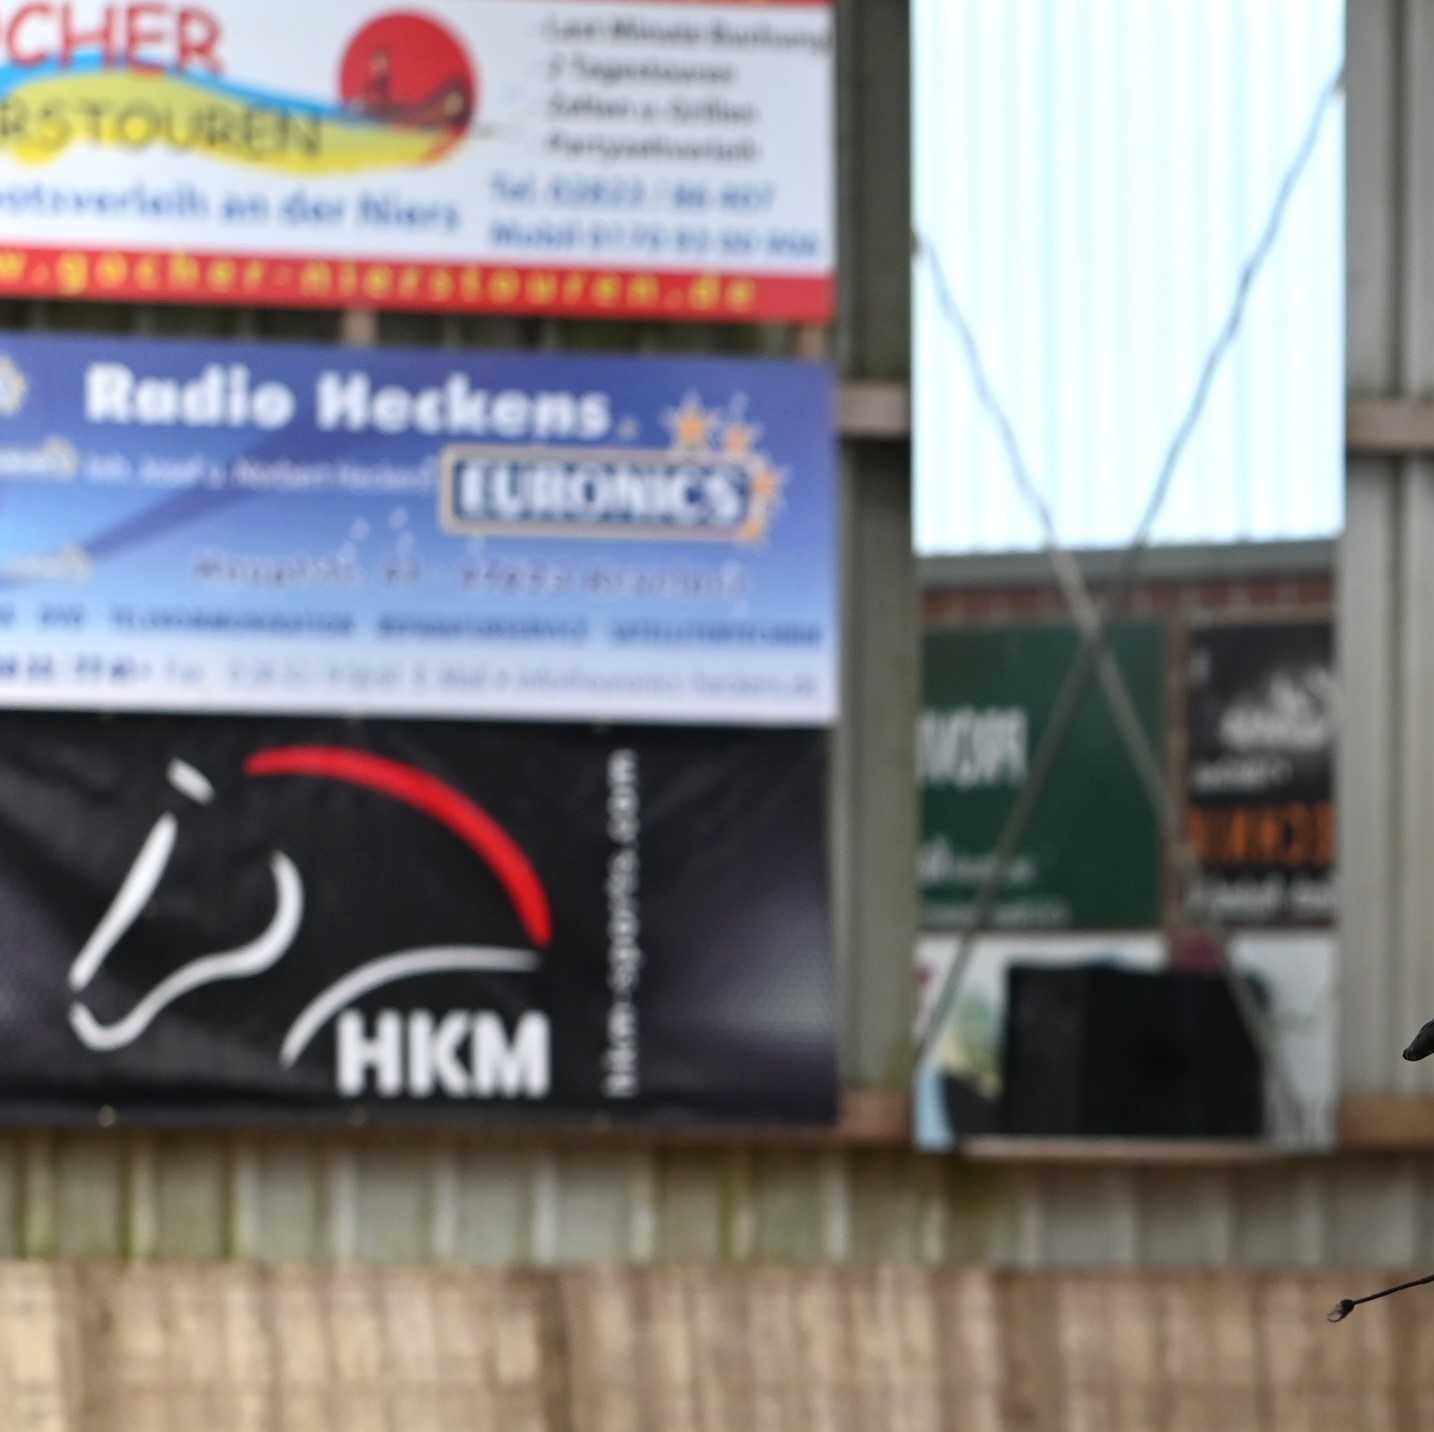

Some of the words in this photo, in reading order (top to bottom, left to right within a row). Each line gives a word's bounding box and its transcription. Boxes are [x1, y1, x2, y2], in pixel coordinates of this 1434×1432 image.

[0, 2, 223, 76] CHER
[86, 363, 296, 430] Radio
[459, 459, 748, 526] EURONICS
[336, 1007, 552, 1099] HKM
